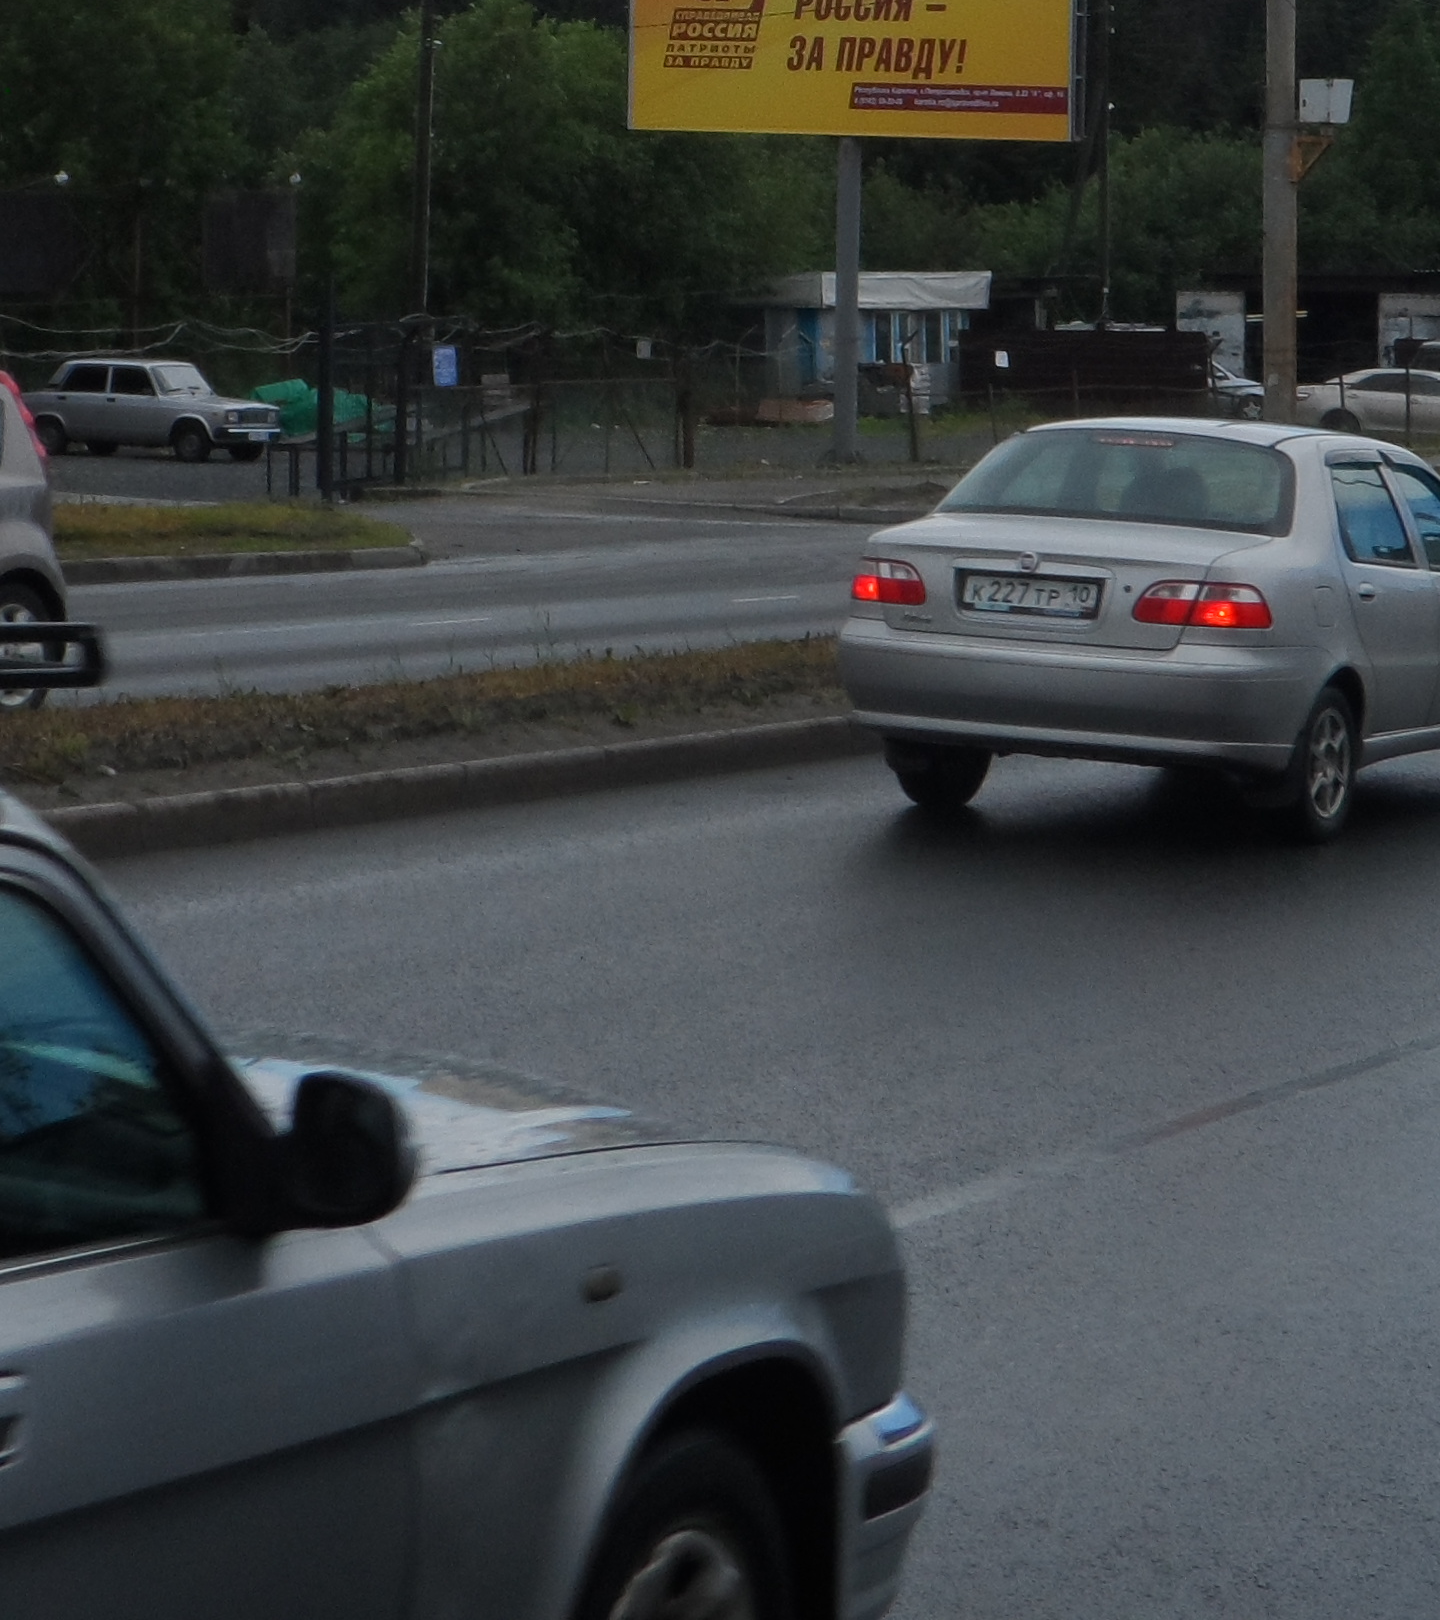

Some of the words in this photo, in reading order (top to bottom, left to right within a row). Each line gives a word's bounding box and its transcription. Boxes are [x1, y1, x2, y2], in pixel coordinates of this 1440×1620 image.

[672, 22, 758, 39] РОССИЯ
[666, 43, 756, 54] ПАТРИОТЫ
[665, 56, 685, 67] ЗА
[690, 57, 750, 69] ПРАВДУ
[787, 36, 824, 72] ЗА
[837, 37, 967, 79] ПРАВДУ!
